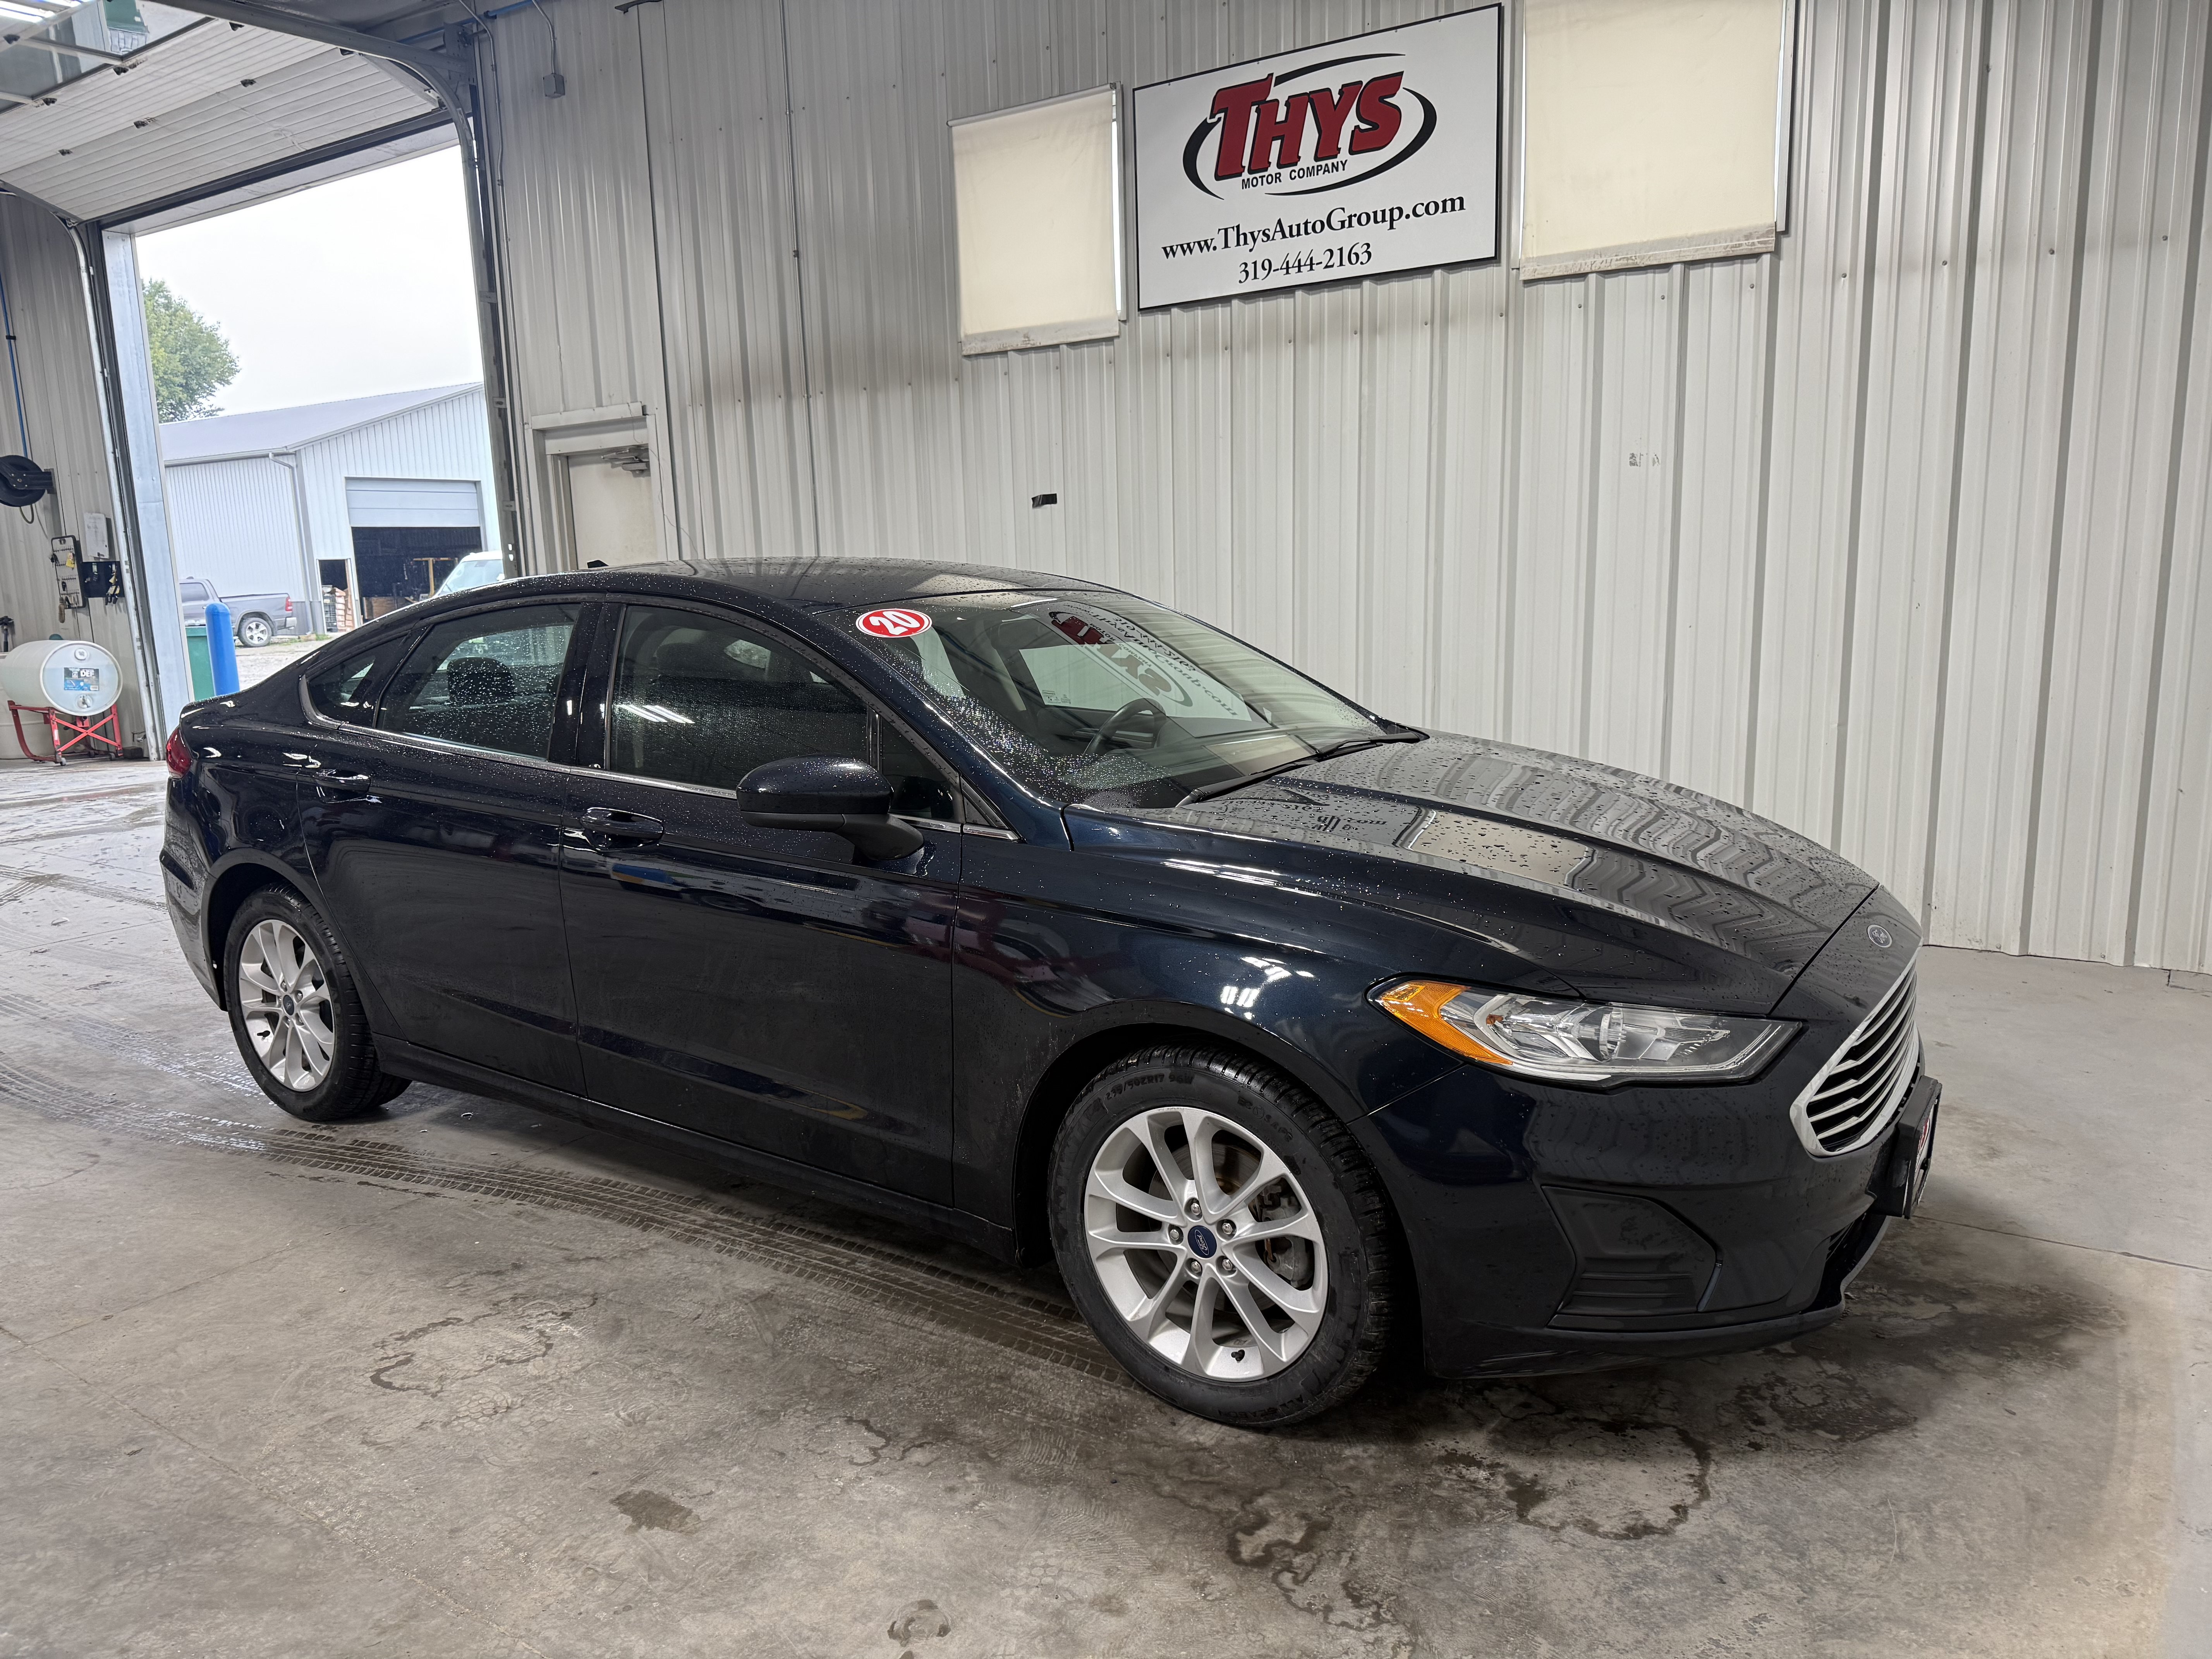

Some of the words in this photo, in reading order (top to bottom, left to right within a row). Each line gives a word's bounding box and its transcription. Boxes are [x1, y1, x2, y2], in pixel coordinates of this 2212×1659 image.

[1242, 172, 1282, 190] MOTOR
[1290, 160, 1348, 180] COMPANY
[1162, 195, 1466, 260] www.ThysAutoGroup.com
[1239, 242, 1372, 284] 319-444-2163
[869, 611, 921, 635] 20
[80, 669, 94, 677] DEF
[1197, 1235, 1207, 1251] Ford
